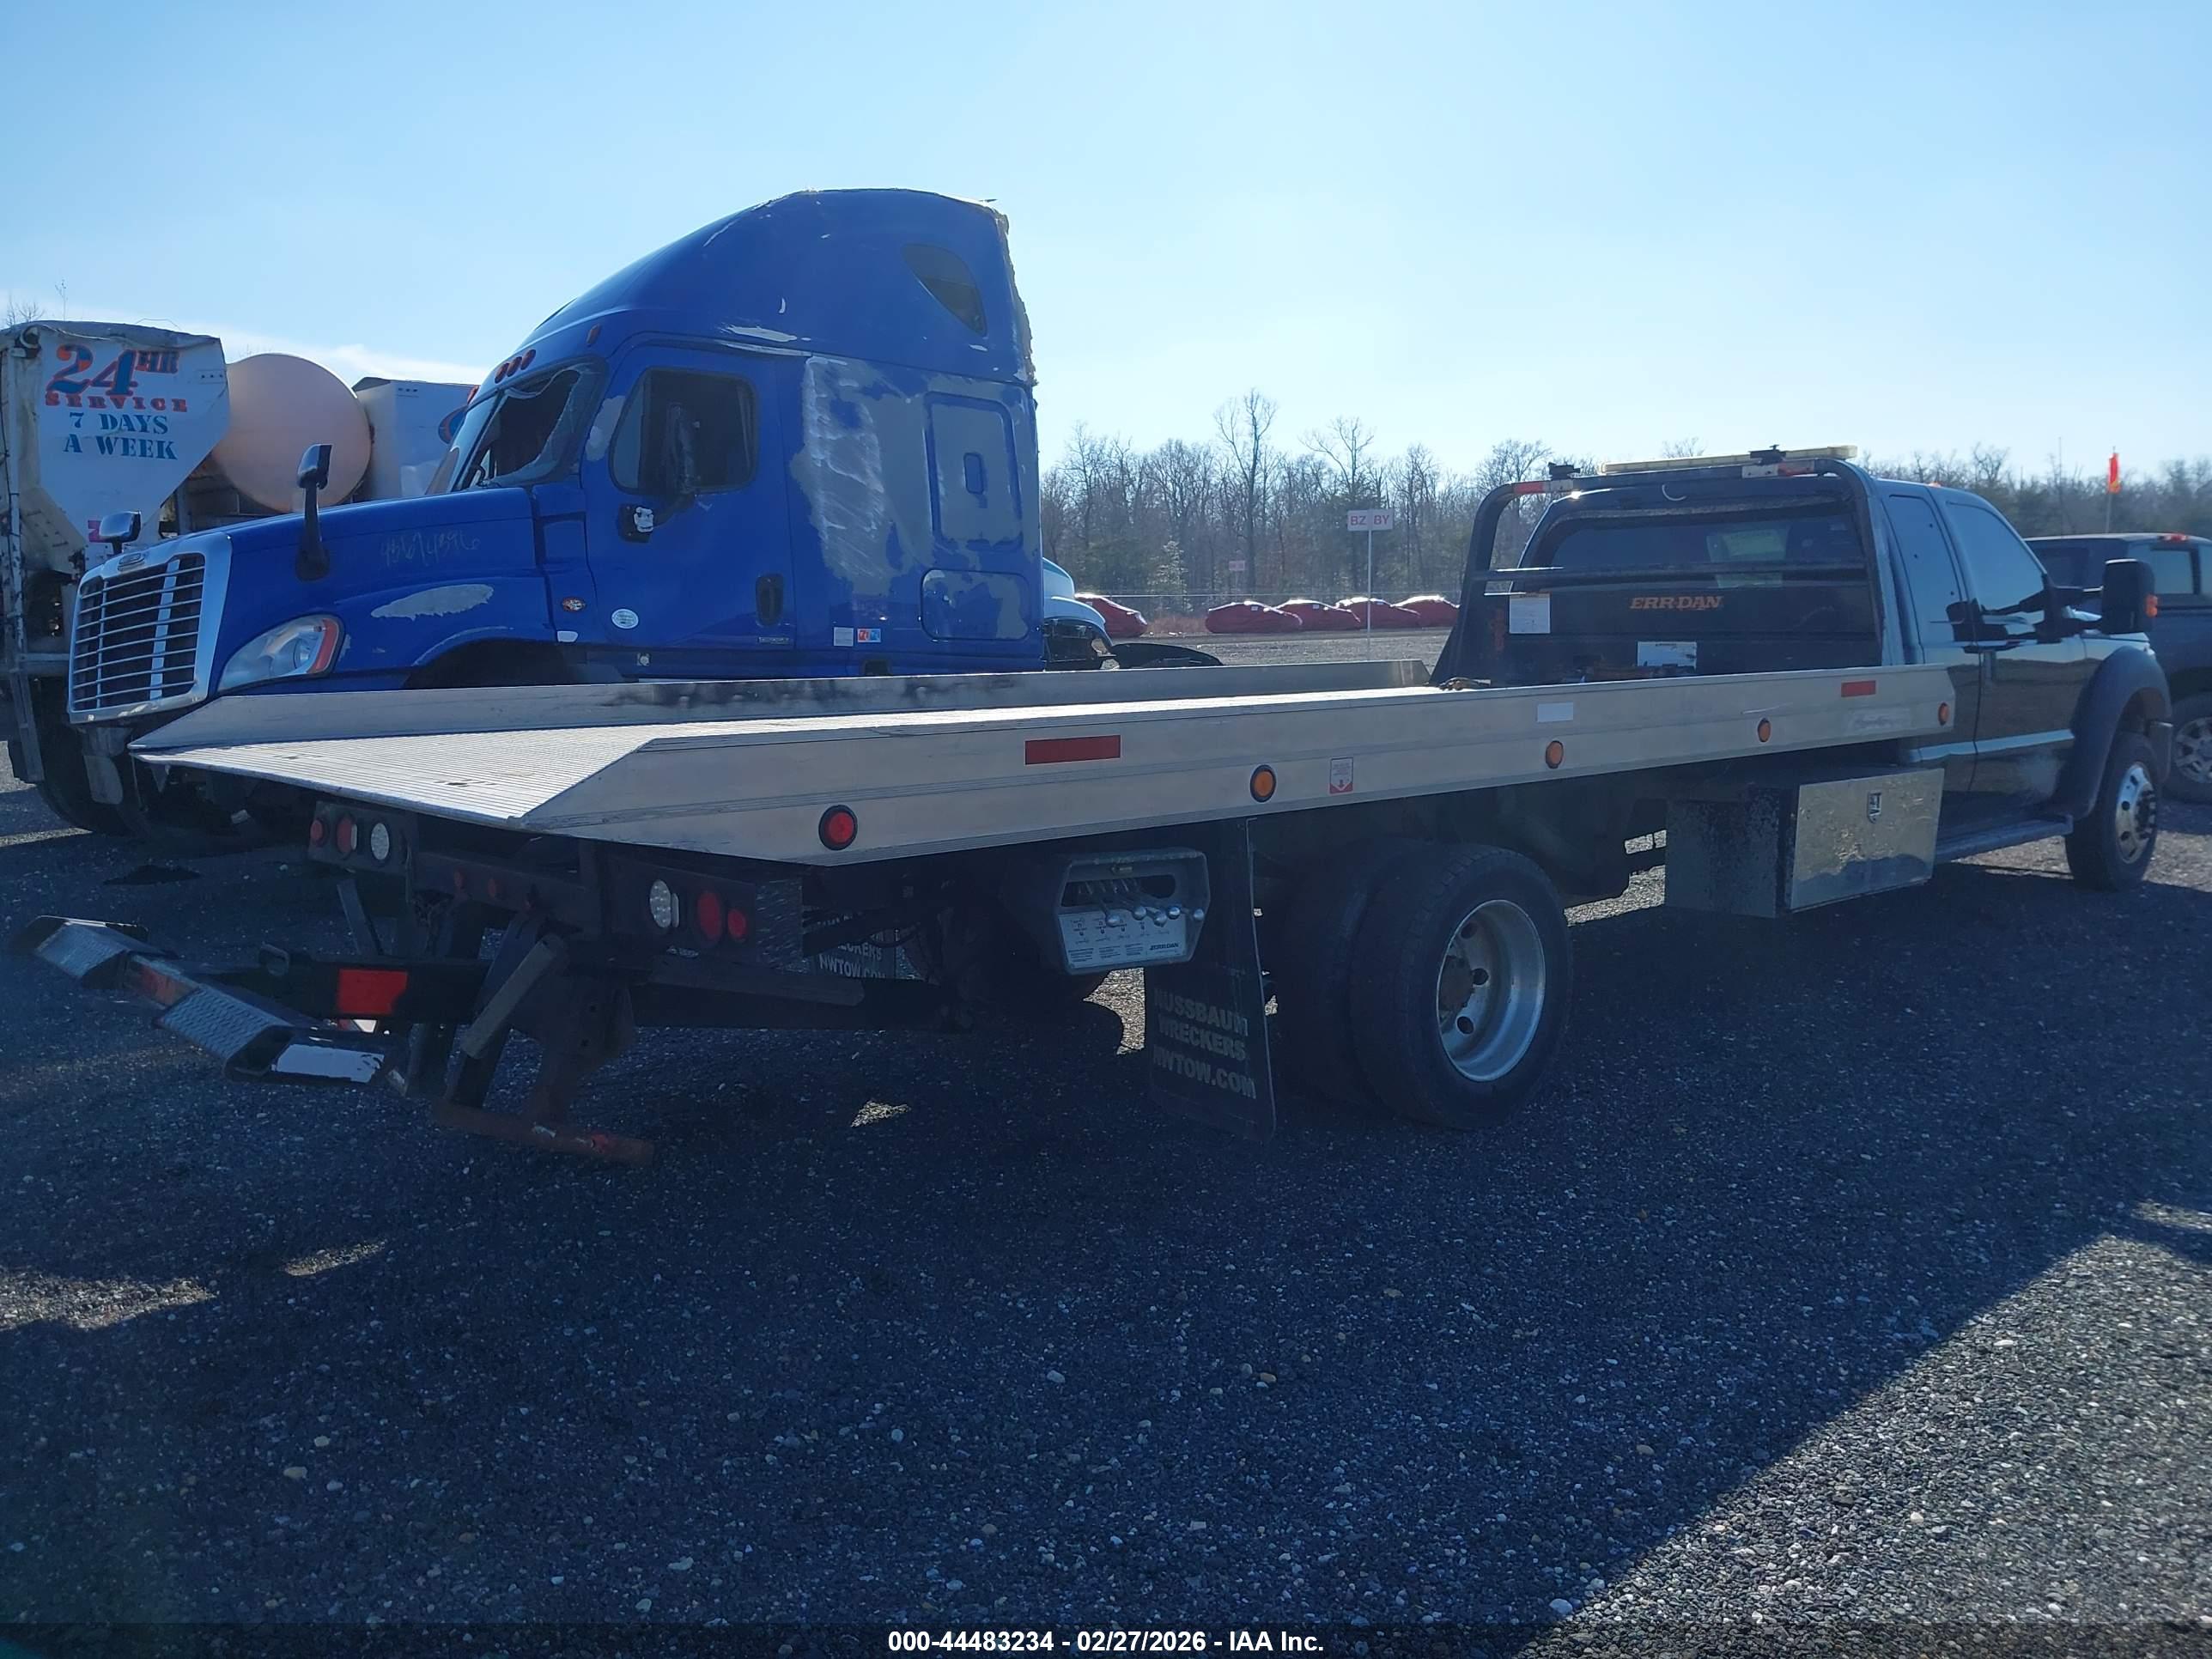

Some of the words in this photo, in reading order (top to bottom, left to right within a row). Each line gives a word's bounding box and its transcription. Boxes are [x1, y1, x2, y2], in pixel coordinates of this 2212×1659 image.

[46, 344, 138, 396] 24
[45, 392, 188, 412] SERVICE
[69, 411, 84, 428] 7
[99, 413, 168, 434] DAYS
[63, 434, 82, 453] A
[96, 436, 178, 460] WEEK
[1351, 515, 1367, 526] BZ
[1373, 514, 1389, 526] BY
[1158, 1012, 1246, 1061] WRECKERS
[1153, 1043, 1257, 1100] NWTOW.COM
